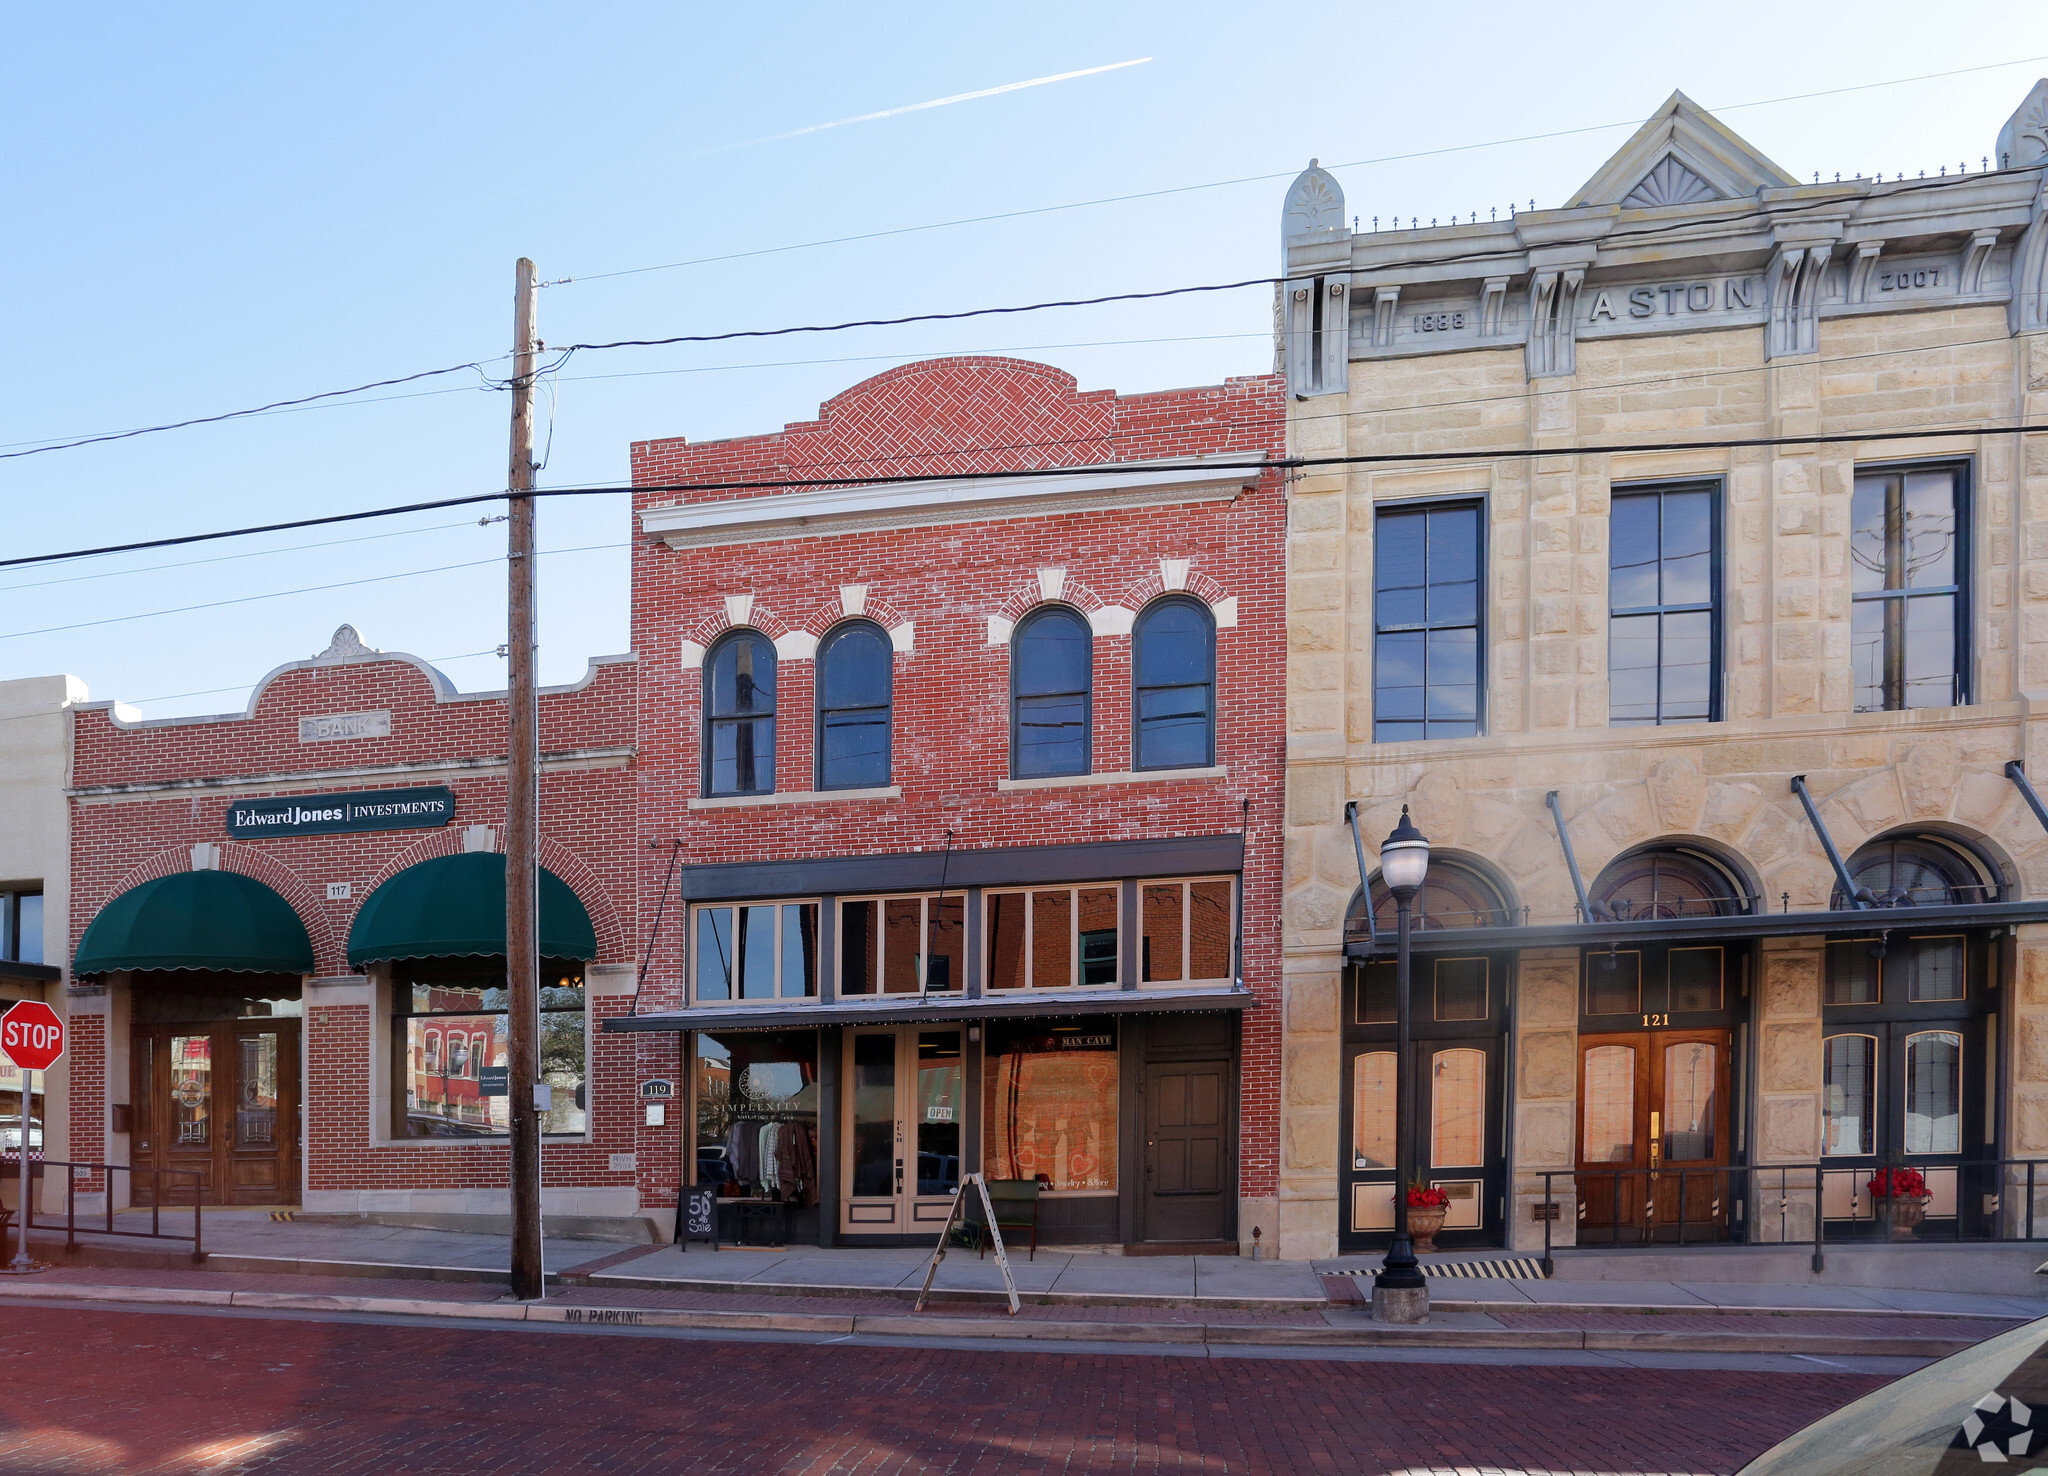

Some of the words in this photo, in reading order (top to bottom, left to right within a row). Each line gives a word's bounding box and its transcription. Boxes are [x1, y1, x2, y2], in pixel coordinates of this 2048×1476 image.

[1590, 277, 1753, 322] ASTON
[1414, 311, 1465, 333] 1888
[317, 717, 370, 738] BANK
[353, 799, 445, 819] INVESTMENTS
[330, 884, 347, 896] 117
[1643, 1013, 1669, 1026] 121
[5, 1020, 61, 1050] STOP
[1062, 1037, 1082, 1045] MAN
[1086, 1035, 1111, 1044] CAVE
[649, 1085, 666, 1095] 119
[713, 1102, 800, 1112] SIMPLEXITY
[930, 1108, 951, 1117] OPEN
[688, 1218, 712, 1233] Sale
[565, 1308, 582, 1321] NO
[589, 1309, 643, 1324] PARKING
